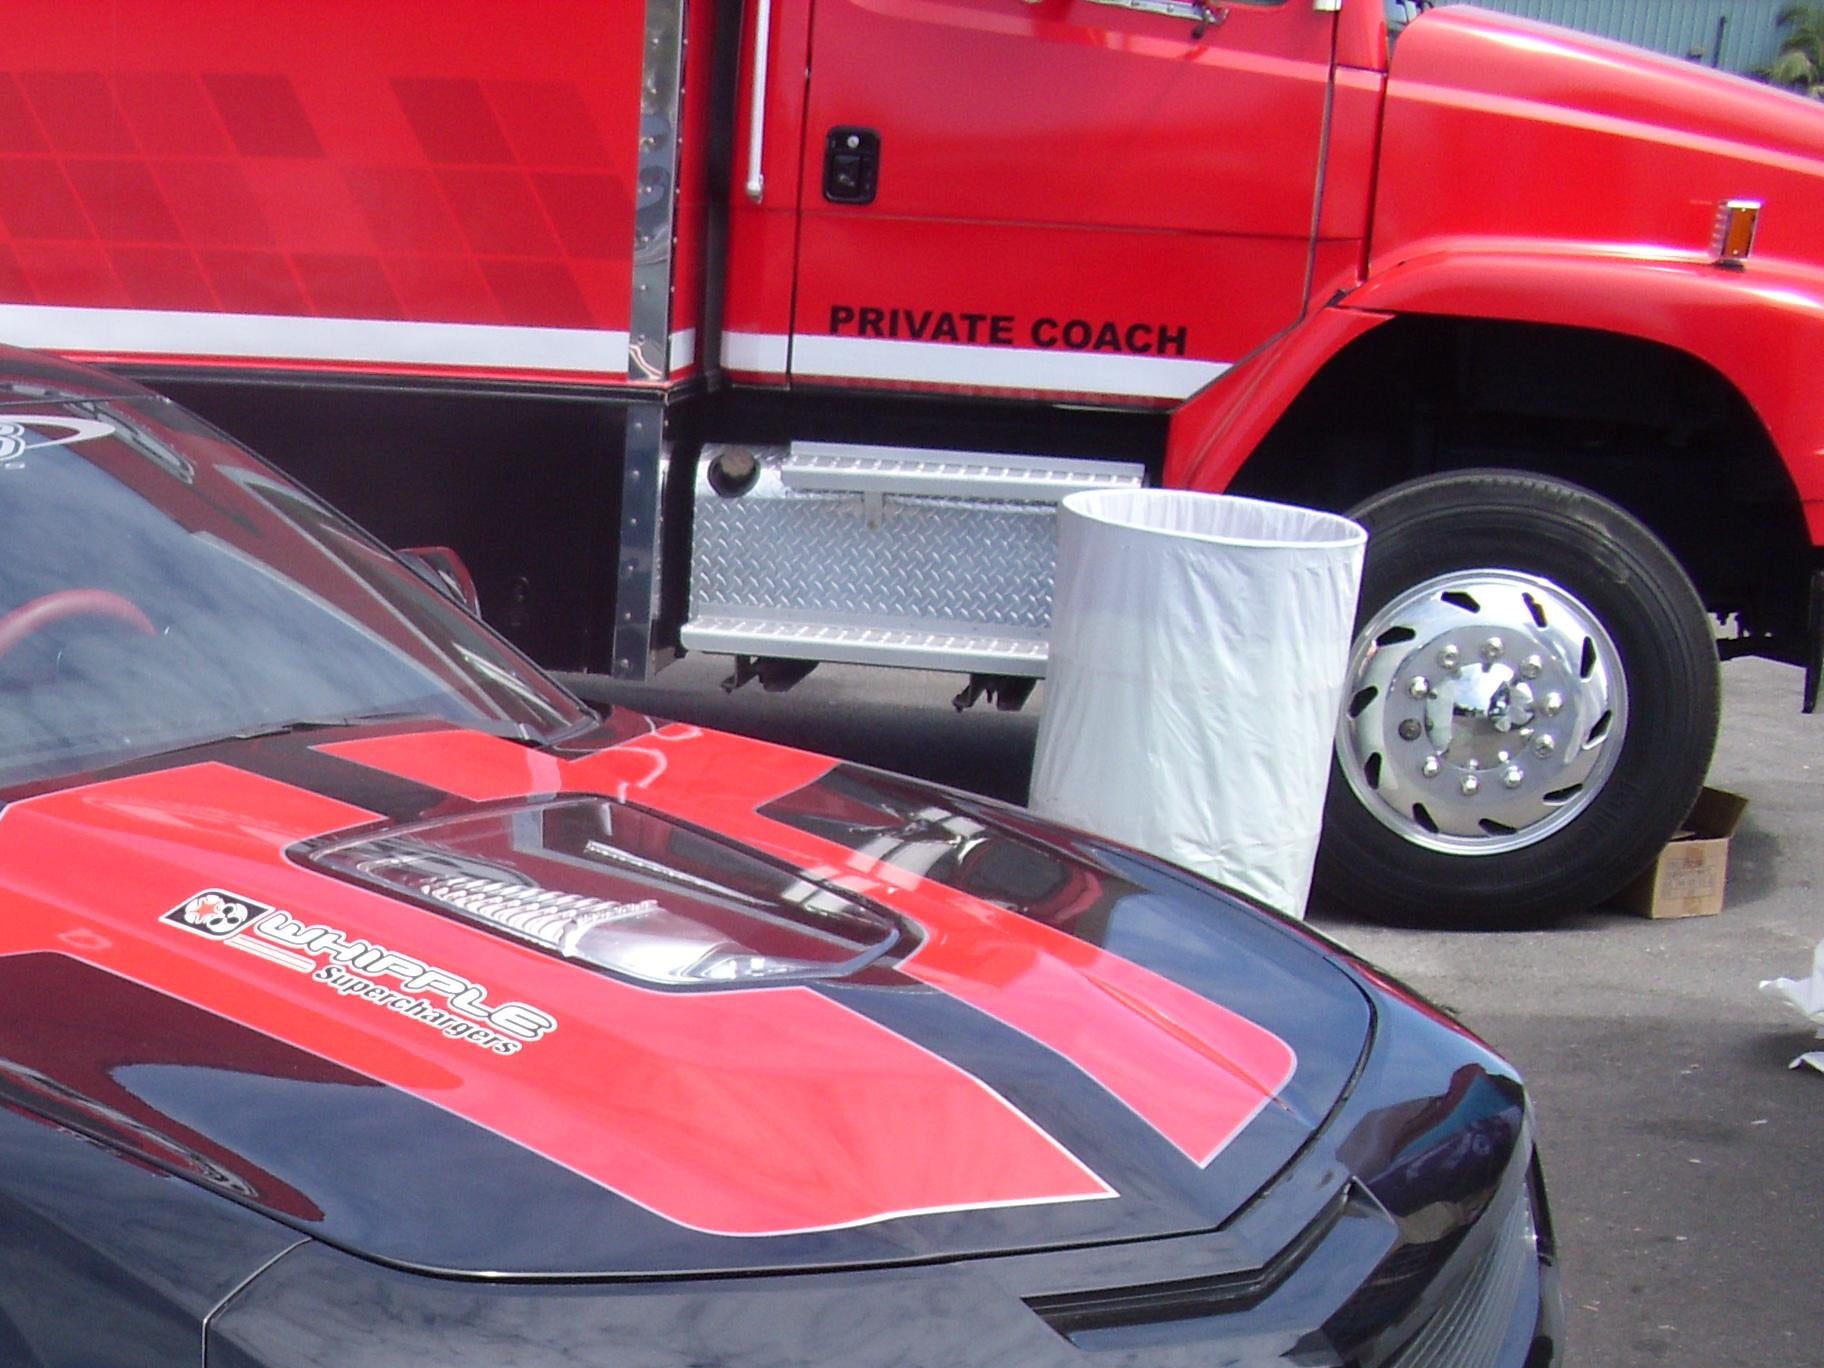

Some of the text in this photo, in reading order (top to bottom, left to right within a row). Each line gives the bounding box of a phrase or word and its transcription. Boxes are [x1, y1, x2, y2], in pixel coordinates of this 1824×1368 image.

[829, 306, 1187, 356] PRIVATE COACH
[254, 907, 558, 1041] WHIPPLE
[314, 962, 524, 1056] Superchargers
